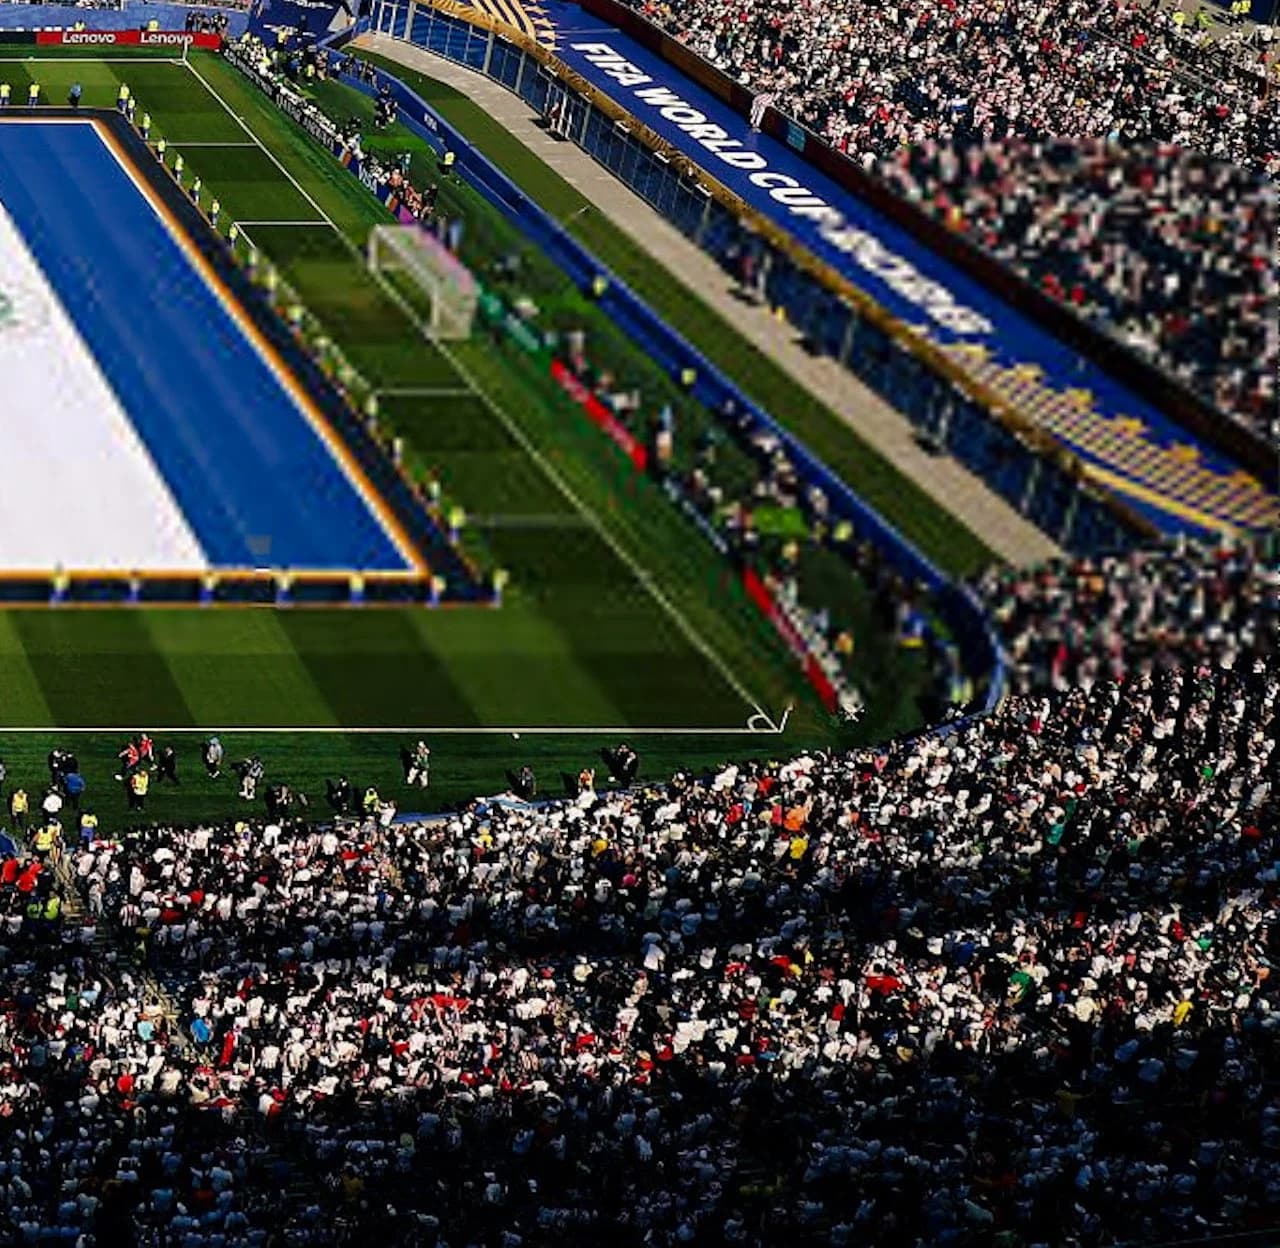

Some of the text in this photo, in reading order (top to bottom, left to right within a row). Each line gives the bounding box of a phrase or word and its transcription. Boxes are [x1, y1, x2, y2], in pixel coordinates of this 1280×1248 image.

[61, 33, 117, 44] Lenovo
[140, 33, 194, 45] Lenovo
[570, 43, 654, 87] FIFA
[634, 87, 768, 169] WORLD
[748, 172, 845, 229] CUP
